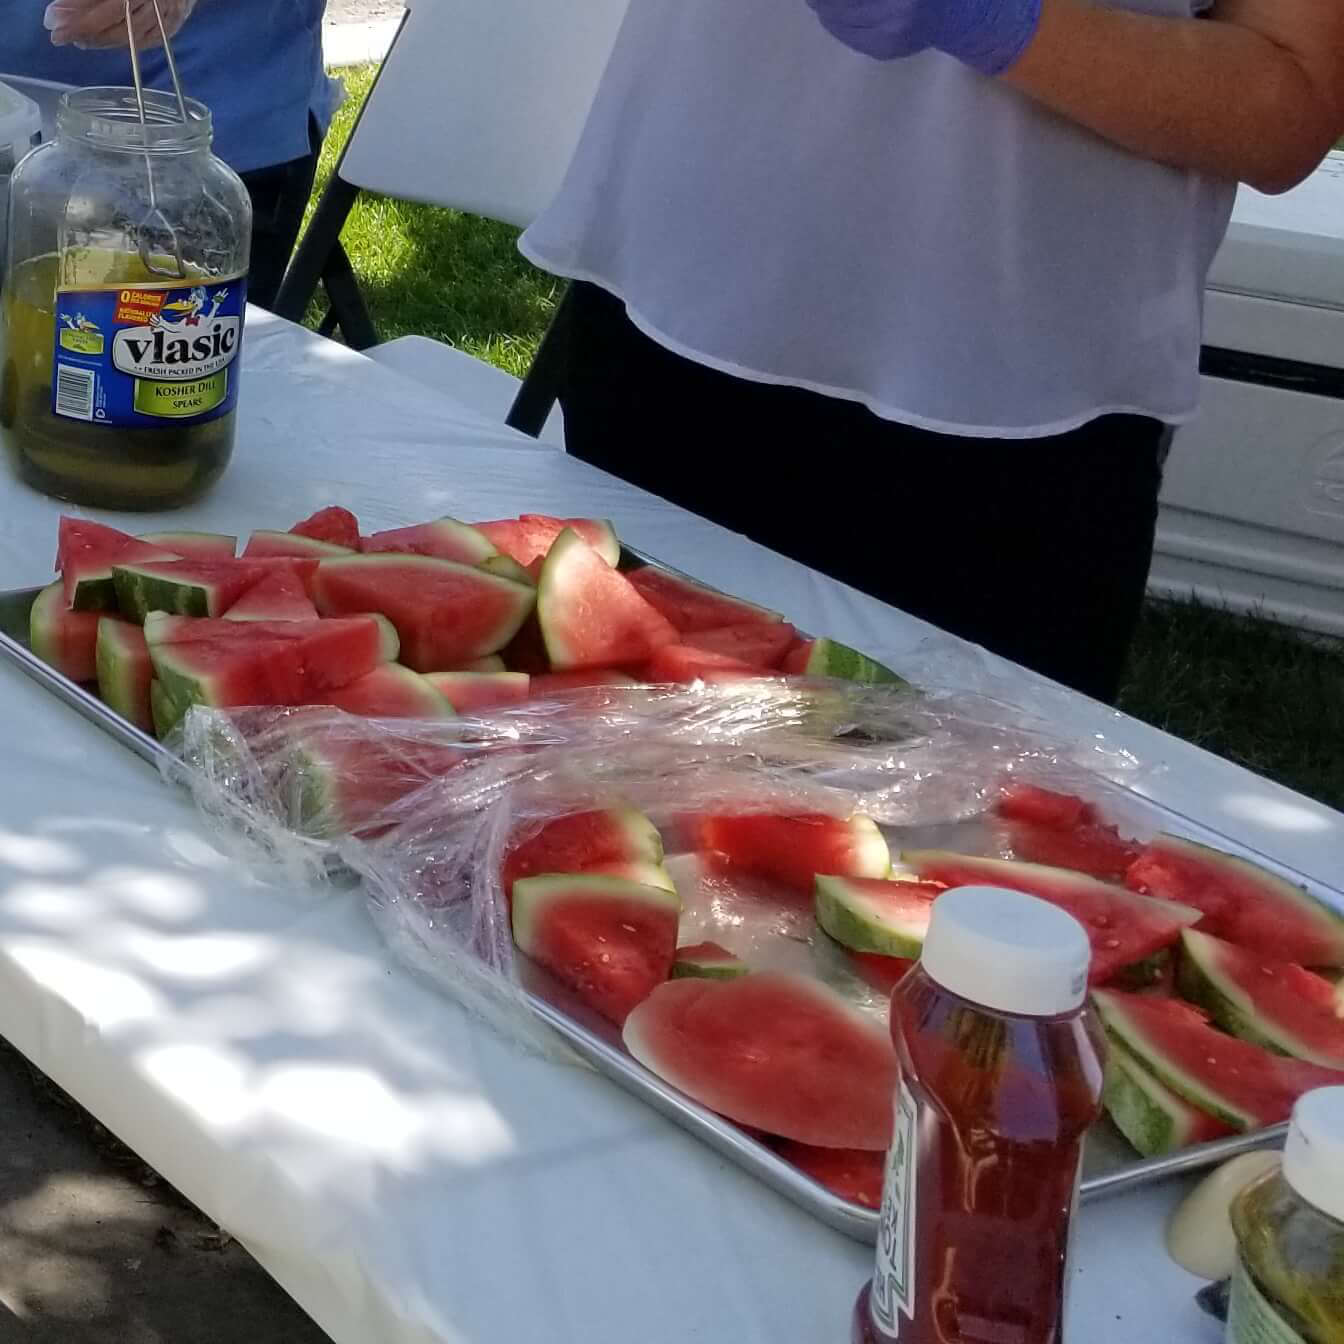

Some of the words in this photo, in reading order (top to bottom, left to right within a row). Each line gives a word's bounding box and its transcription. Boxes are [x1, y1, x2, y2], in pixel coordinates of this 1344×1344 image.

[123, 324, 236, 365] vlasic
[155, 384, 196, 397] KOSHER
[198, 379, 216, 392] DILL
[172, 398, 202, 409] SPEARS
